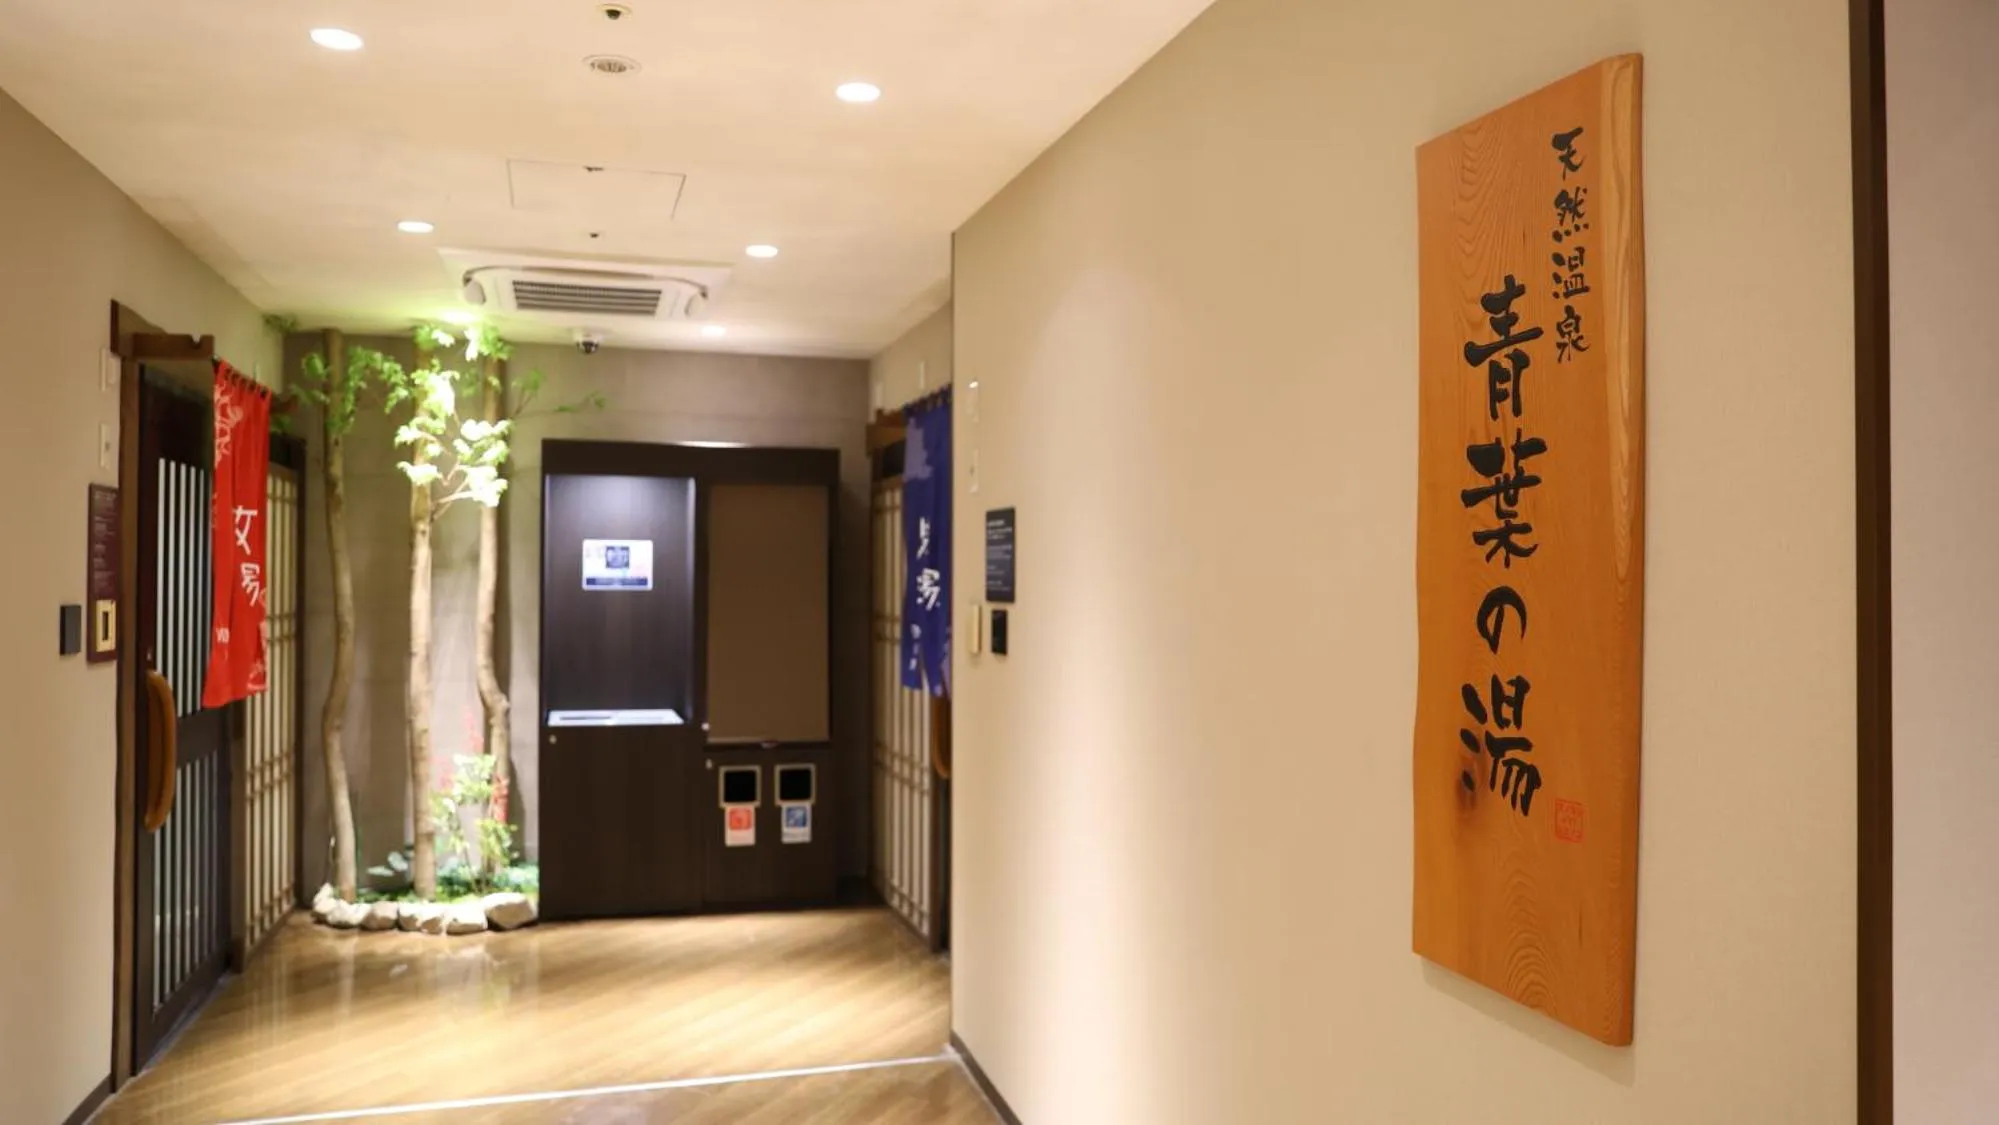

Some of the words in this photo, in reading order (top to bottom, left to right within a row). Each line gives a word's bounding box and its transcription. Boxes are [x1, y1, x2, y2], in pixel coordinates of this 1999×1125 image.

[1551, 126, 1591, 363] 天然温泉
[1461, 274, 1548, 817] 青葉の湯
